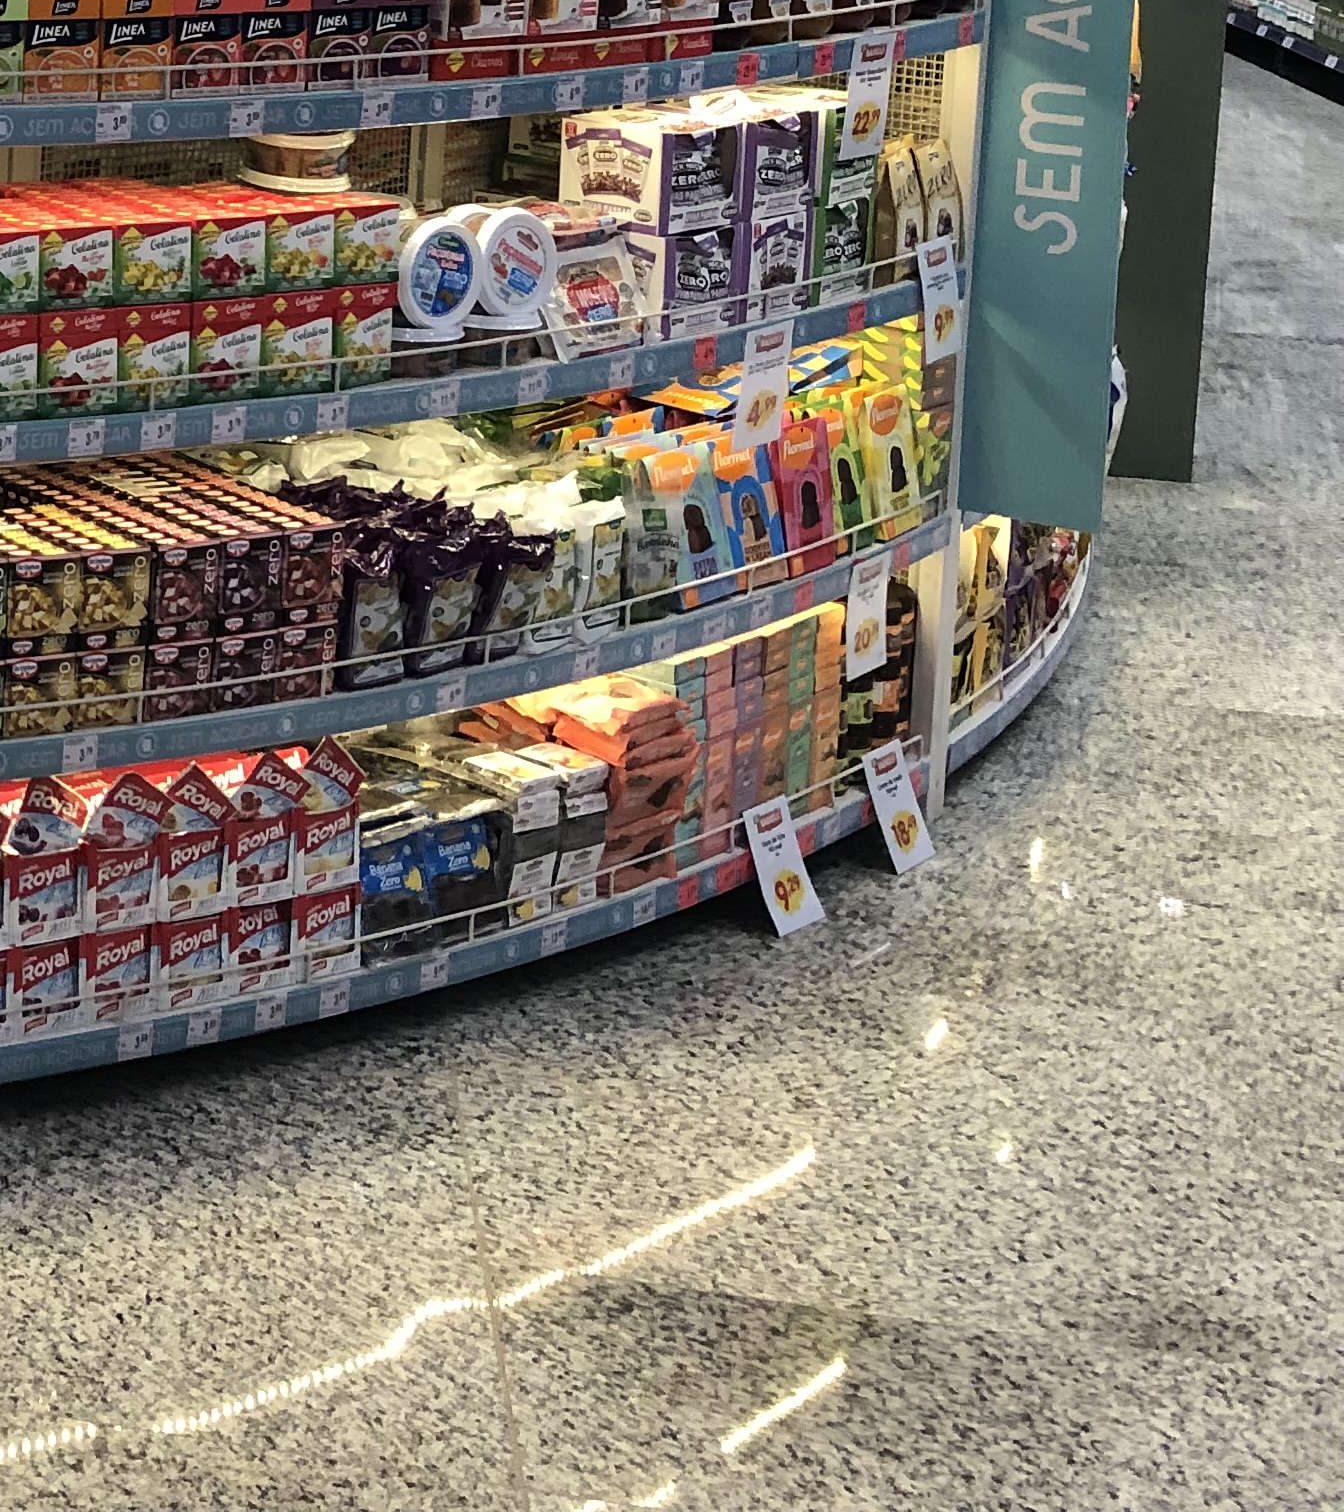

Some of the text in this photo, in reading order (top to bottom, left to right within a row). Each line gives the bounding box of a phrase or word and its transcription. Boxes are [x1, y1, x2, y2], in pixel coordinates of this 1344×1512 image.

[1014, 83, 1088, 257] SEM
[307, 816, 352, 847] Royal
[18, 861, 72, 892] Royal
